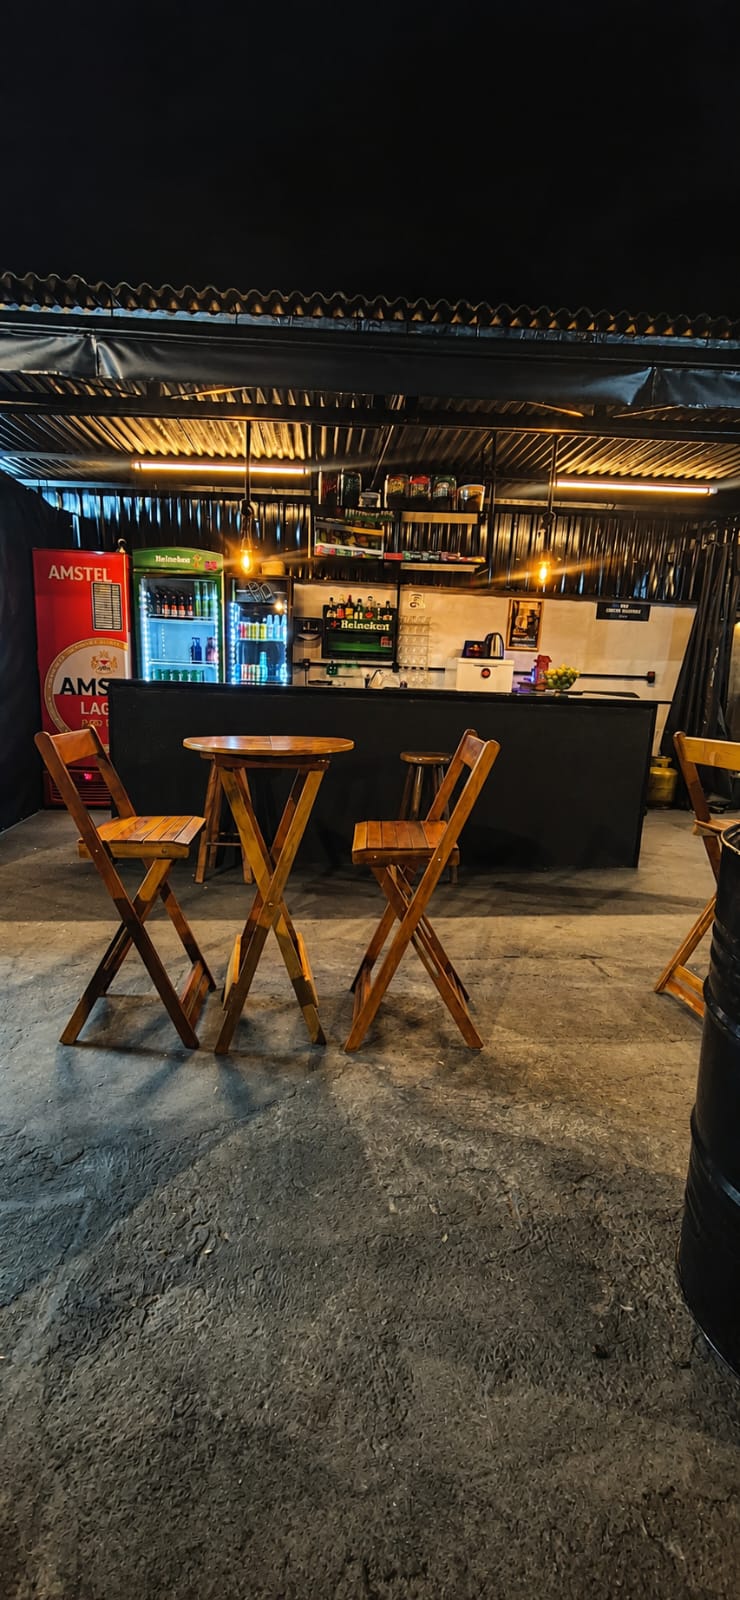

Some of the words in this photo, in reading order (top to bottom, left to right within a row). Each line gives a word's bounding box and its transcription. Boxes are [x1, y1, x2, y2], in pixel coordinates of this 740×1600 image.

[155, 555, 191, 565] Heineken
[48, 565, 112, 583] AMSTEL
[341, 619, 390, 632] Heineken
